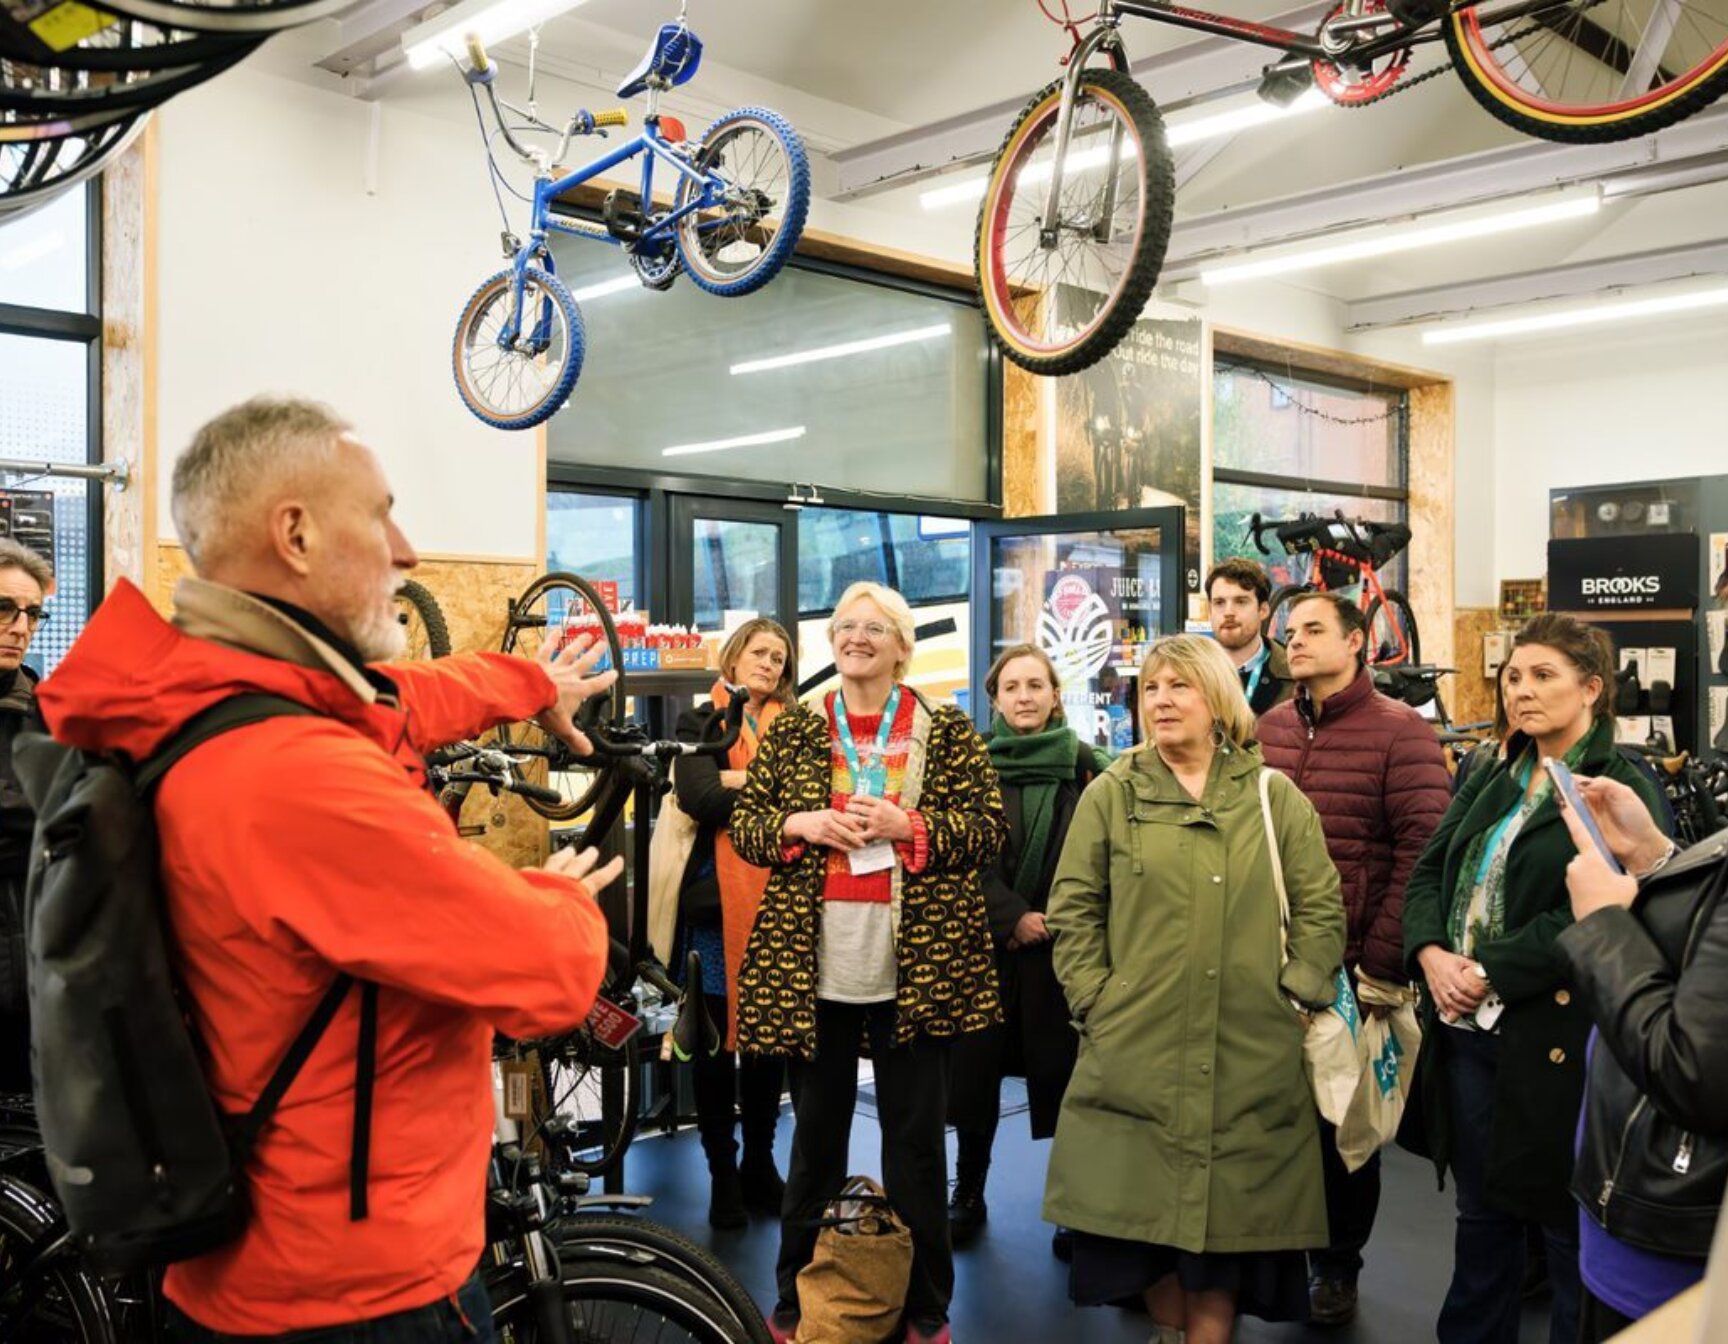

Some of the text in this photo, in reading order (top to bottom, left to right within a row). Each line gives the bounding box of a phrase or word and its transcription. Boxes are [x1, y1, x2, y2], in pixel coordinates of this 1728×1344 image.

[1130, 328, 1199, 356] ride the road
[1136, 347, 1158, 366] ride
[1160, 353, 1178, 371] the
[1179, 357, 1199, 379] day
[1110, 577, 1144, 598] JUICE
[1581, 575, 1660, 595] BROOKS
[1598, 596, 1643, 604] ENGLAND
[623, 652, 657, 666] PREP
